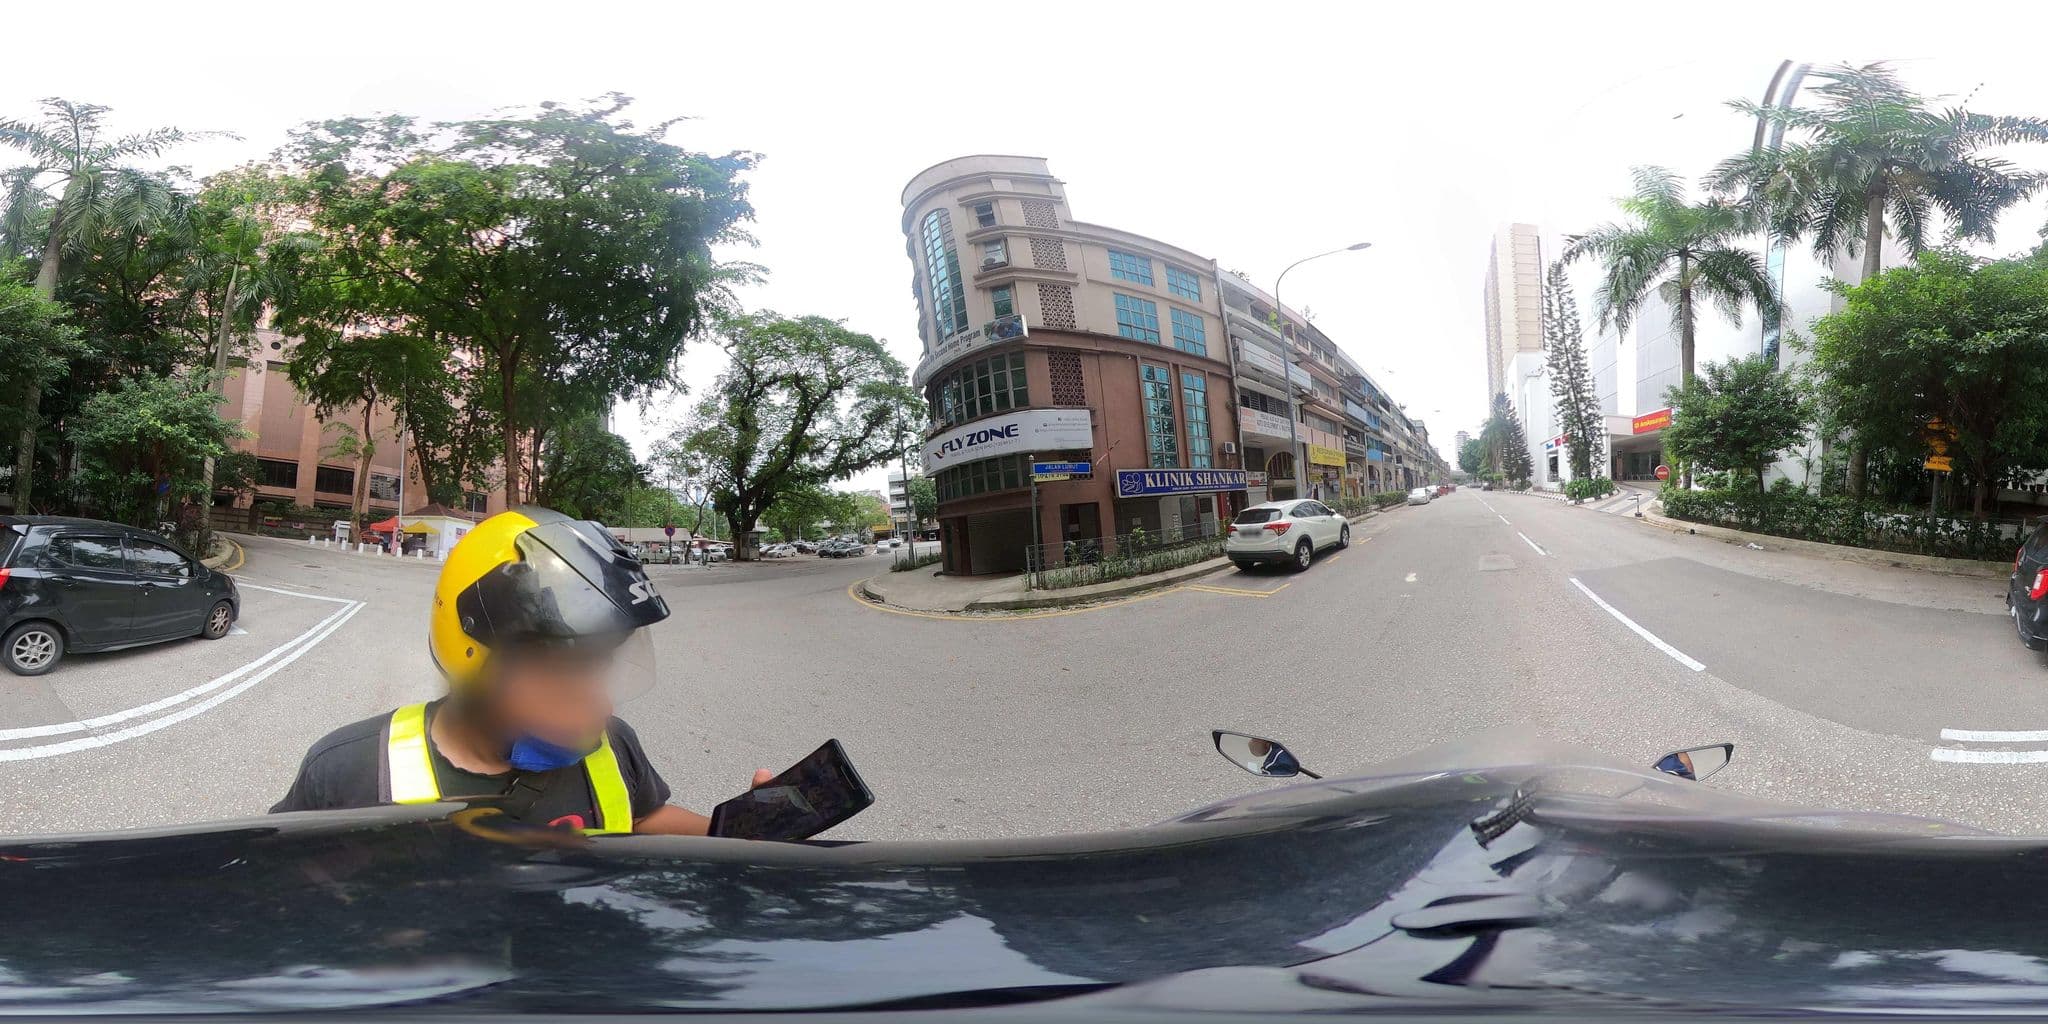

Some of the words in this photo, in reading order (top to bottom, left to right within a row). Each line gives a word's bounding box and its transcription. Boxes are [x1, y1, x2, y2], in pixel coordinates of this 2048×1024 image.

[947, 340, 959, 352] Home
[960, 330, 981, 344] Program
[1145, 472, 1194, 488] KLINIK
[1196, 472, 1246, 486] SHANKAR
